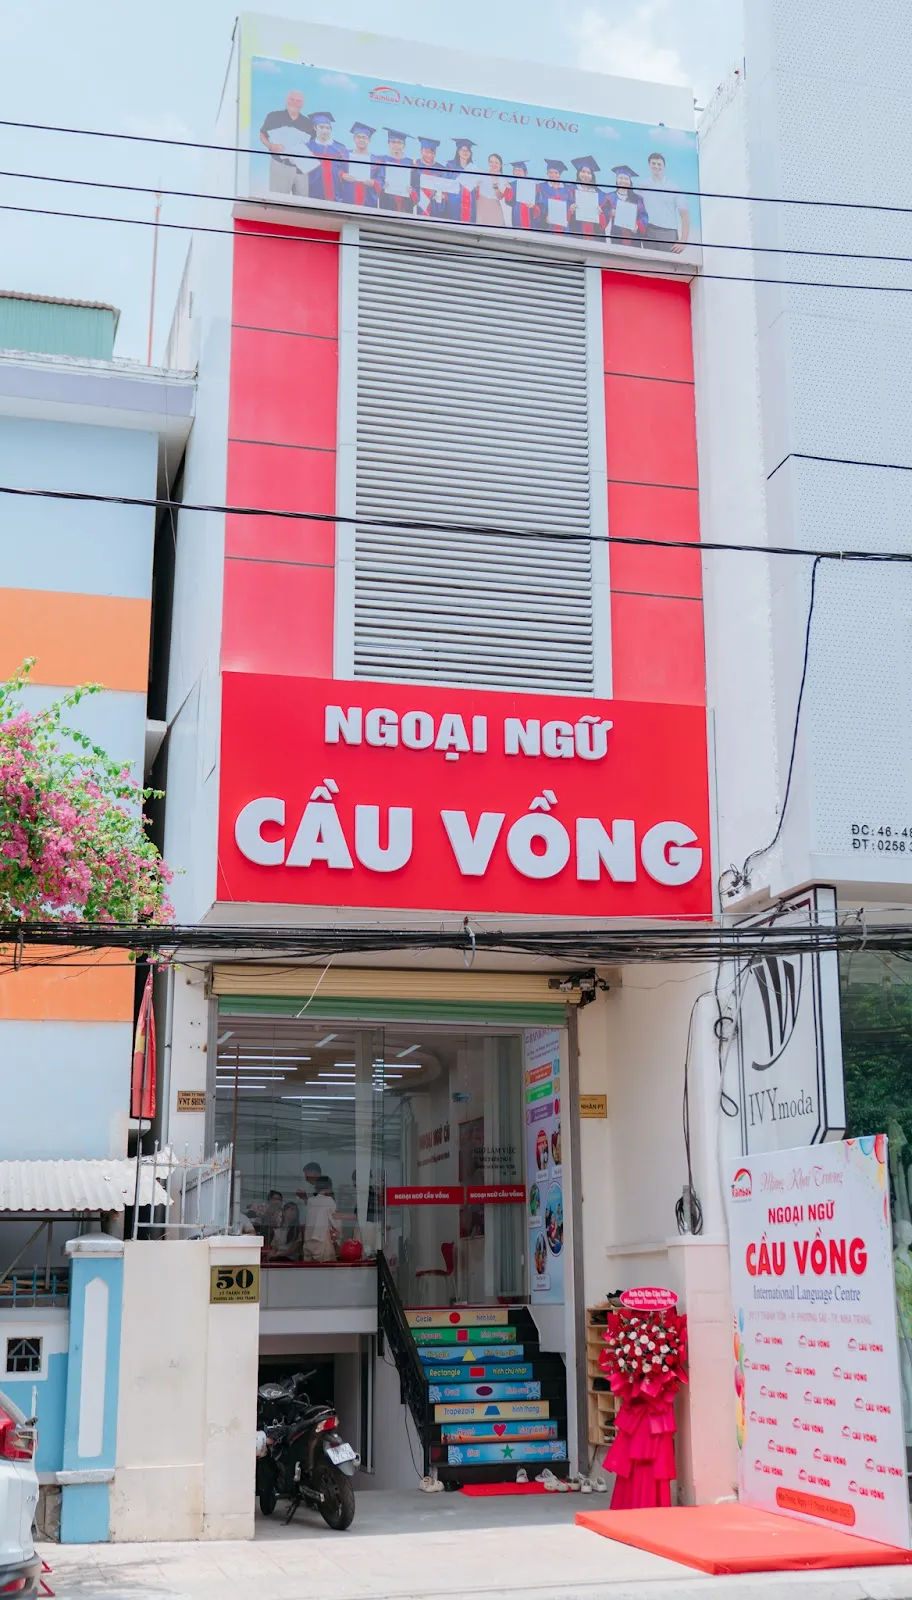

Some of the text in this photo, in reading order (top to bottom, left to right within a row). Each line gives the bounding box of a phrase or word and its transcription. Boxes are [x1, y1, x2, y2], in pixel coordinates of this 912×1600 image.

[324, 705, 614, 761] NGOẠI NGỮ
[234, 778, 703, 886] CẦU VỒNG
[768, 1199, 835, 1227] NGOẠI NGỮ
[746, 1227, 868, 1276] CẦU VỒNG
[216, 1269, 254, 1289] 50
[753, 1284, 861, 1305] International Language Centre
[415, 1314, 432, 1322] Circle
[429, 1368, 461, 1378] Rectangle
[444, 1407, 475, 1416] Trapezoid
